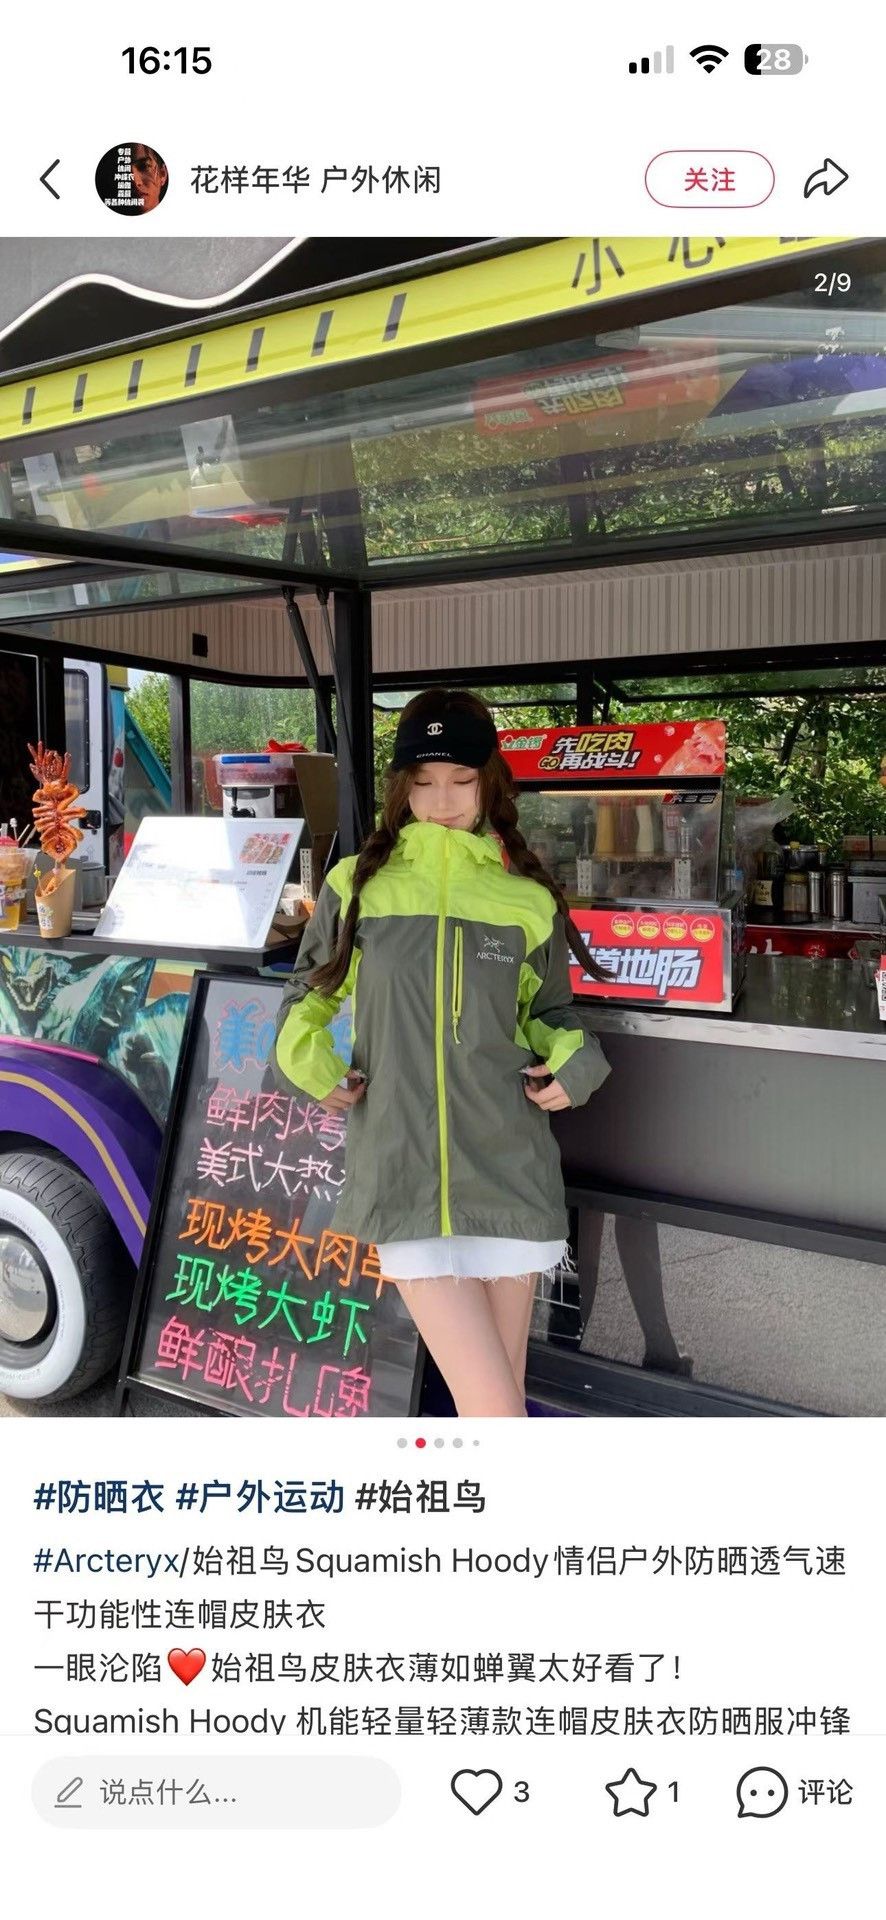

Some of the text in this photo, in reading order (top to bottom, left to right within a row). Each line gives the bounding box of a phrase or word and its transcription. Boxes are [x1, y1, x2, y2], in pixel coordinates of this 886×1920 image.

[551, 732, 634, 754] 先吃肉
[559, 751, 641, 770] 再战斗!
[569, 933, 701, 996] 道地肠
[165, 1254, 370, 1358] 现烤大虾
